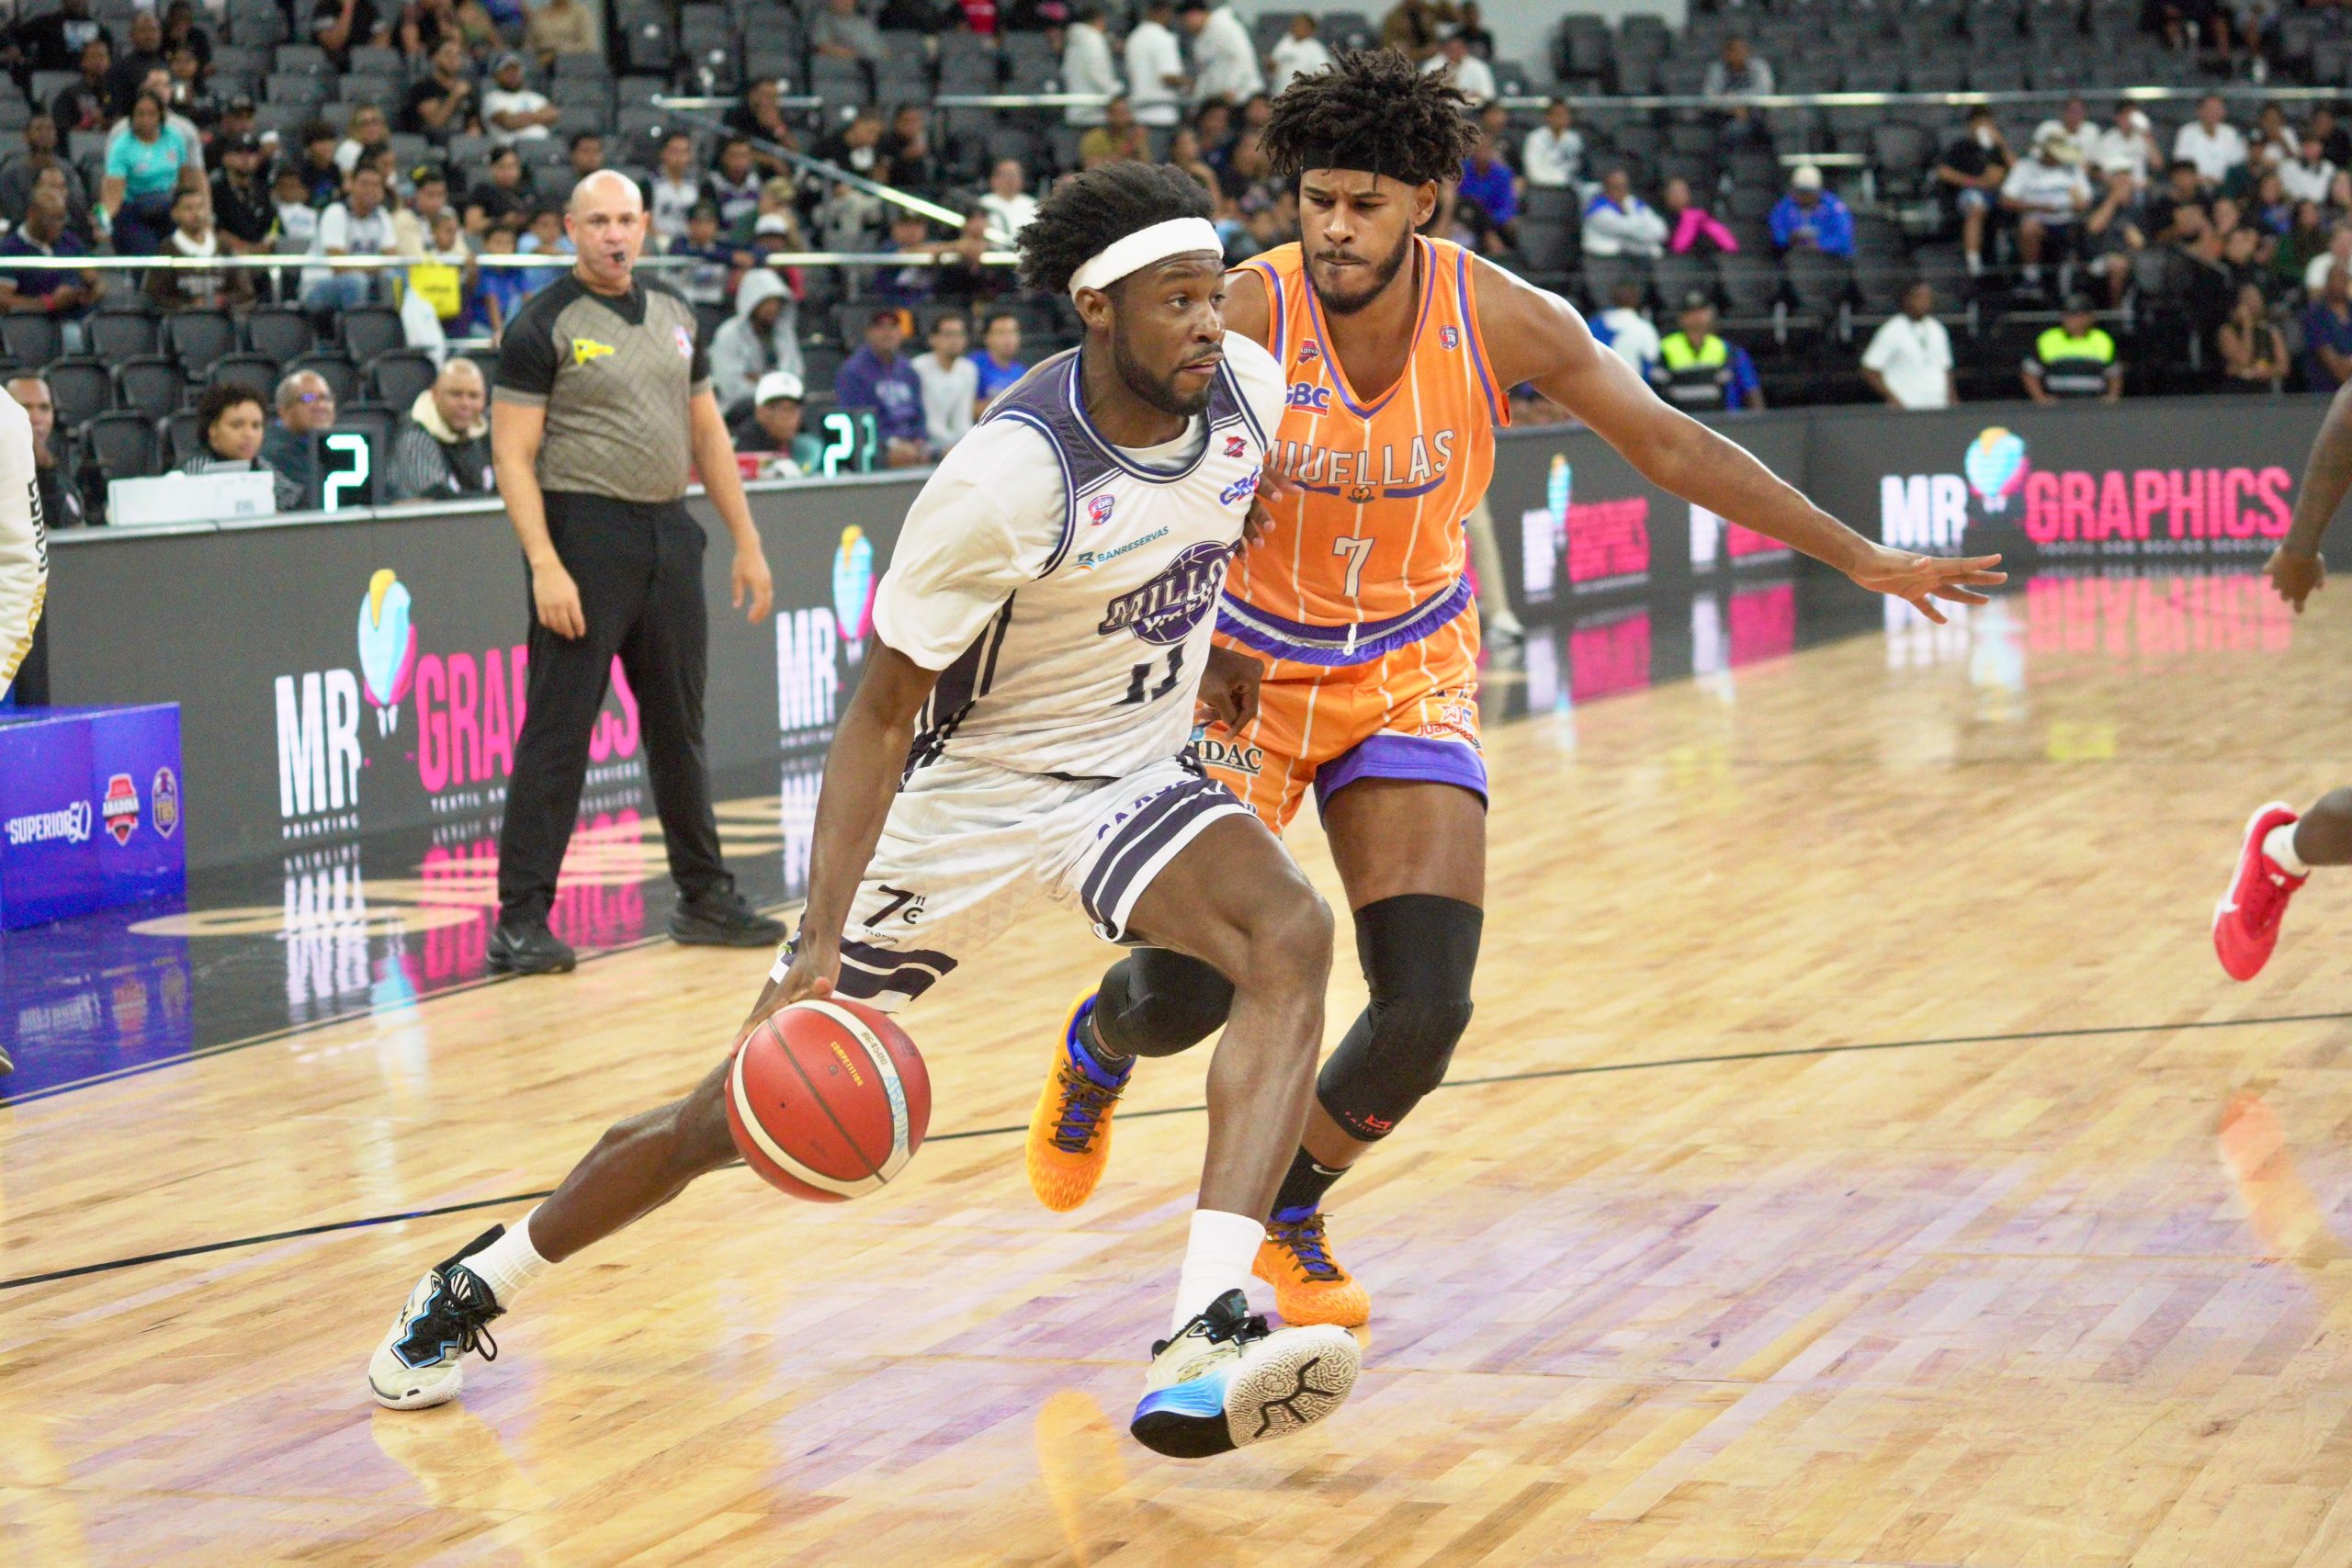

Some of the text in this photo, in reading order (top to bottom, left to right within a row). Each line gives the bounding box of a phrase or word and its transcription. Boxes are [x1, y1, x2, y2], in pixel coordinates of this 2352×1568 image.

[1881, 474, 1968, 548] MR
[2025, 467, 2293, 544] GRAPHICS
[1097, 526, 1170, 563] BANRESERVAS
[1332, 536, 1375, 597] 7
[1103, 549, 1235, 630] MILLO
[776, 606, 838, 731] MR
[1110, 642, 1188, 706] 11
[276, 669, 361, 818] MR
[831, 1041, 865, 1088] COMPETITION
